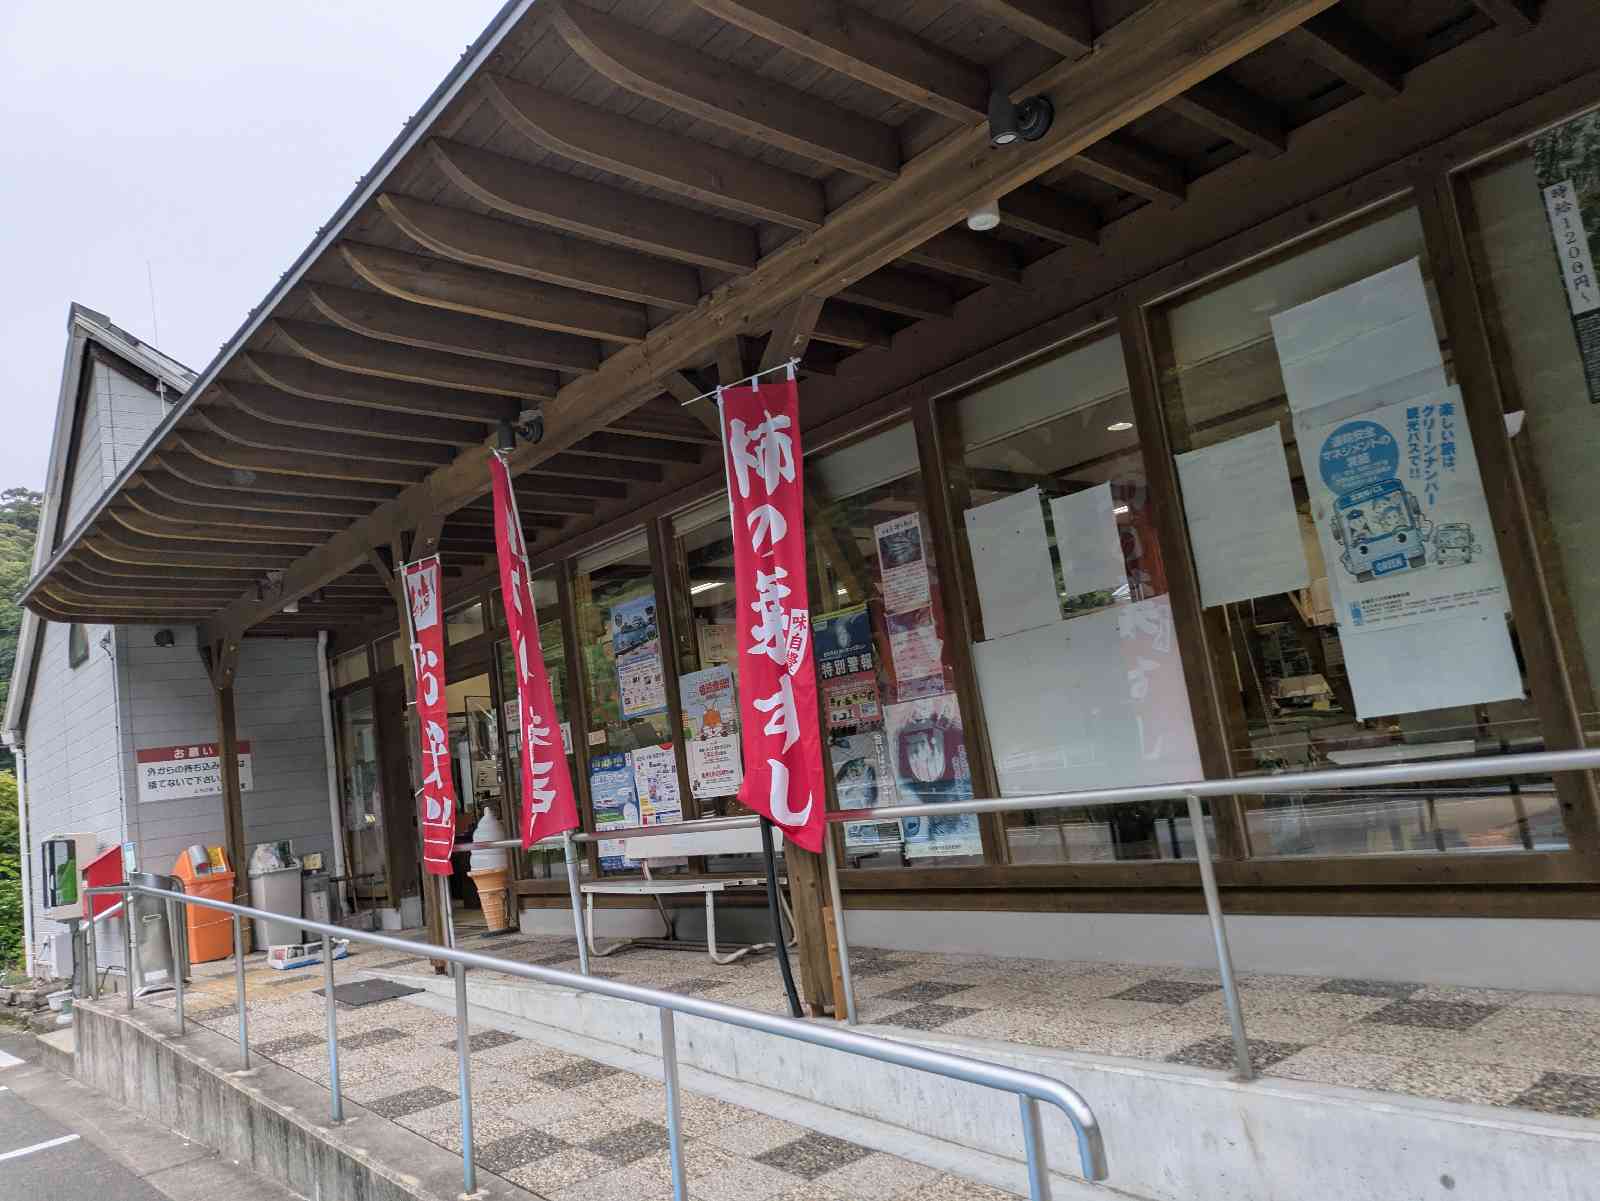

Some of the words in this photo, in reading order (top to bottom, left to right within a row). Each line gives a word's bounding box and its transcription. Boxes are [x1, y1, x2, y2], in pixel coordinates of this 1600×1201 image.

[729, 408, 813, 827] 柿の葉すし
[174, 743, 214, 759] お願い
